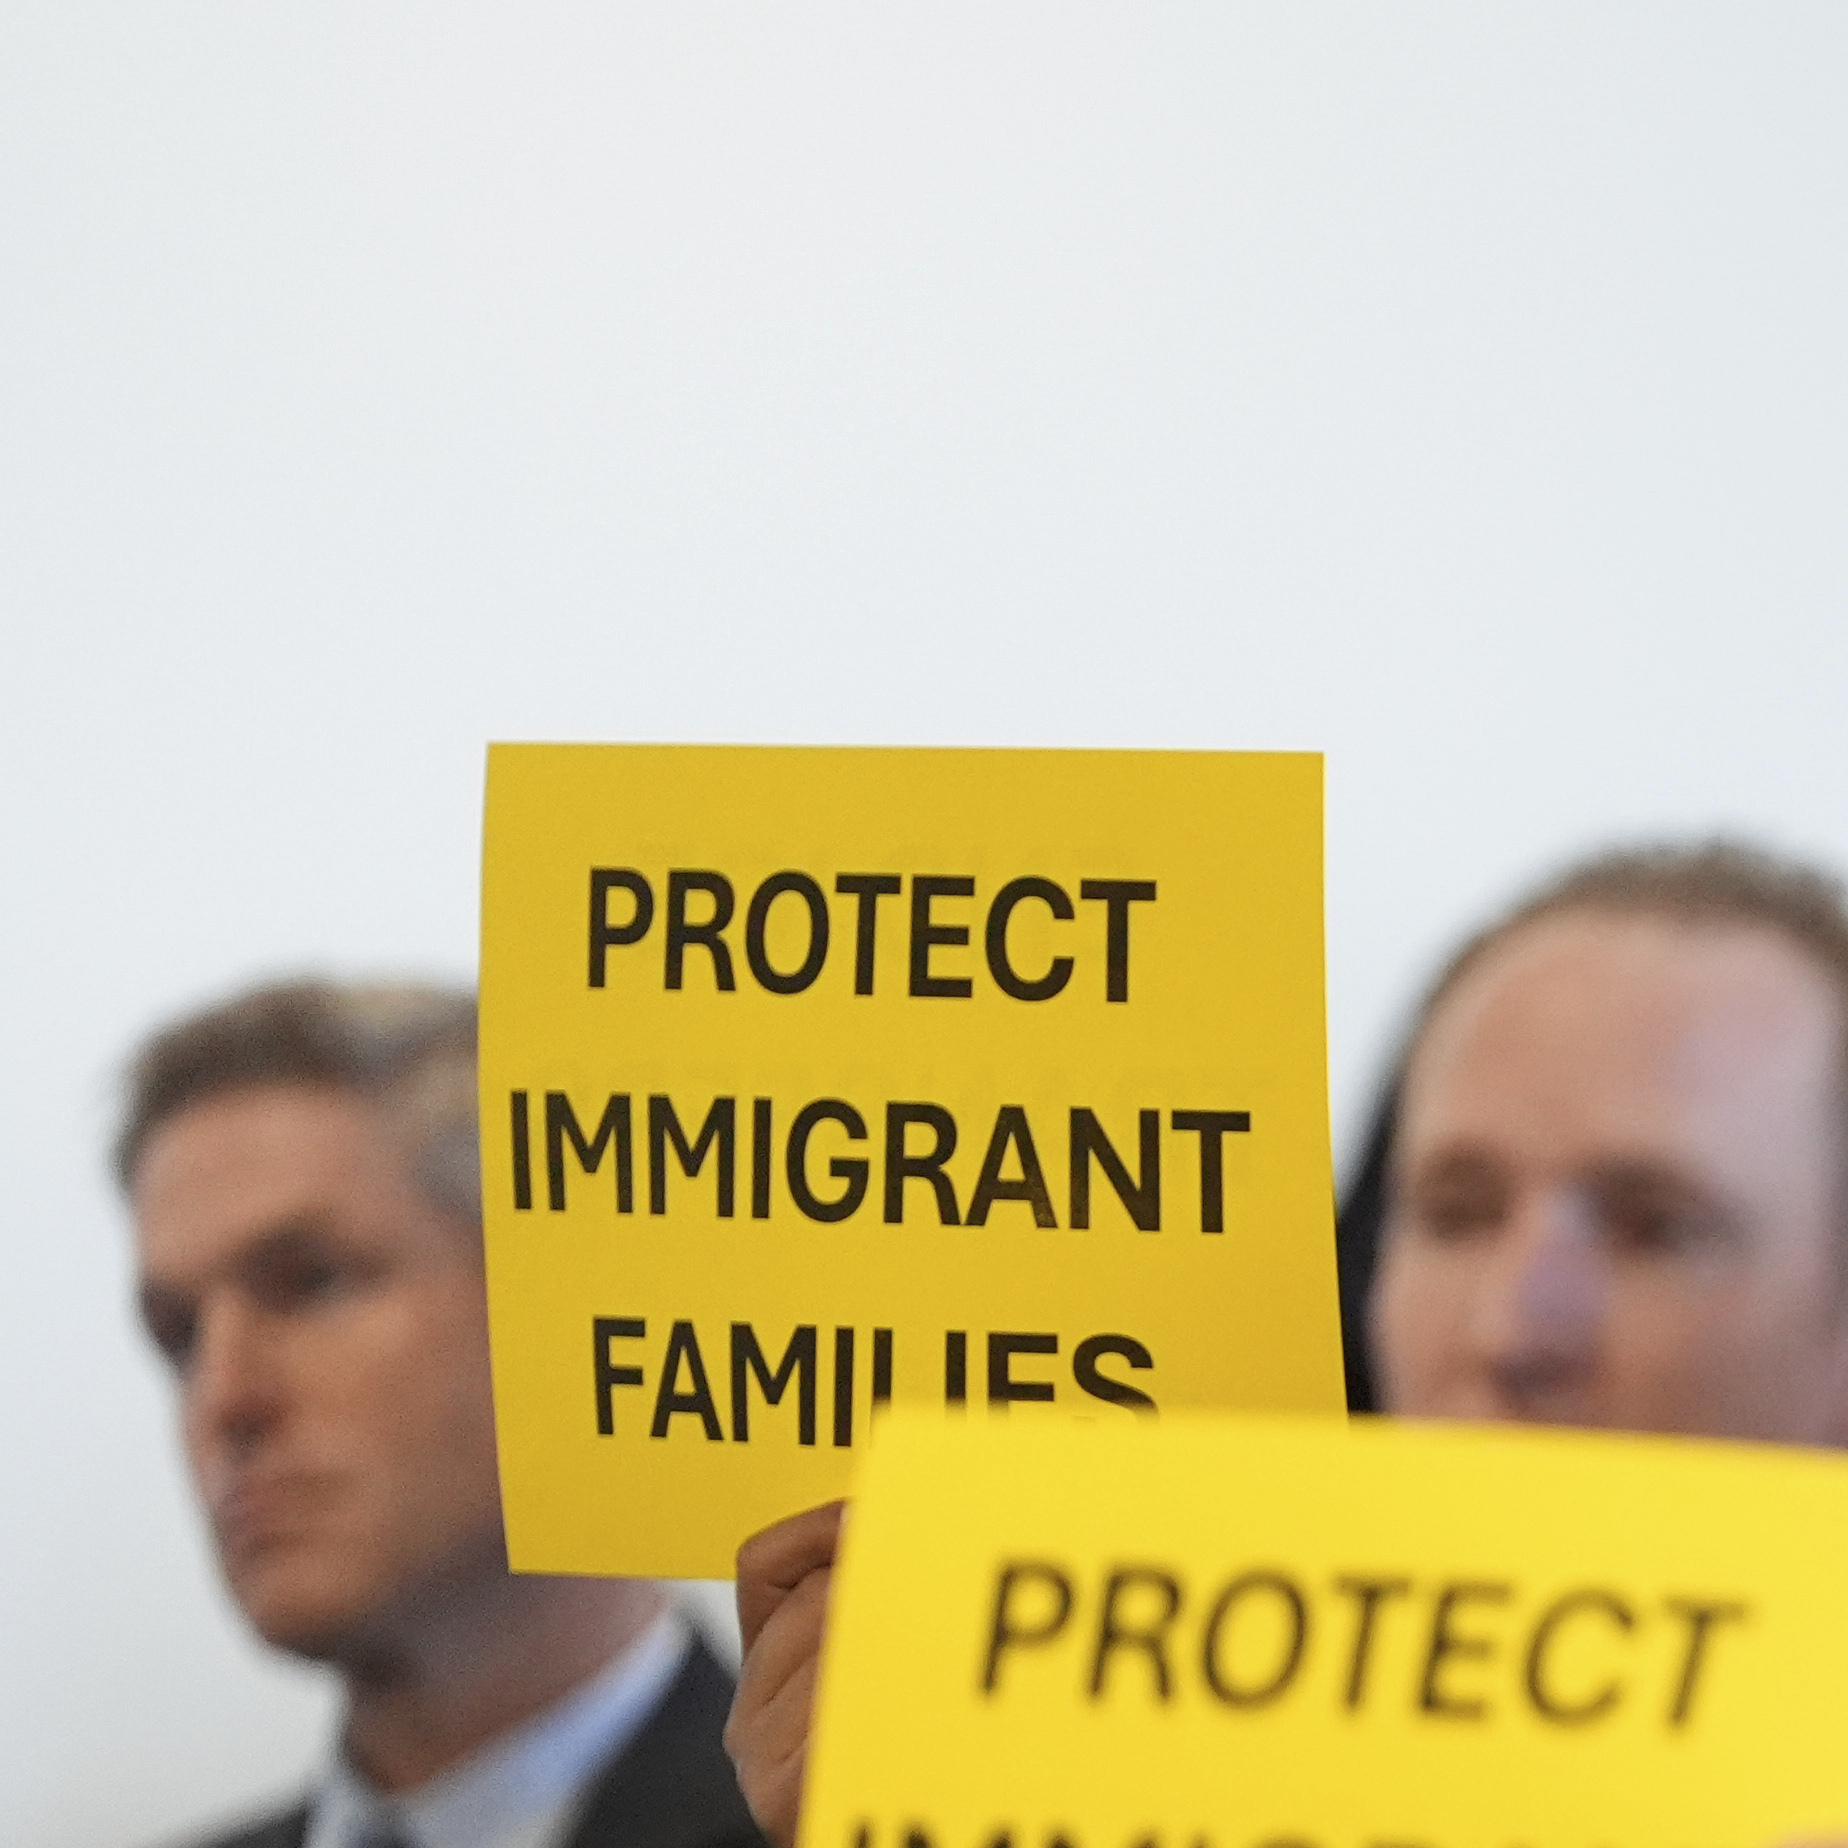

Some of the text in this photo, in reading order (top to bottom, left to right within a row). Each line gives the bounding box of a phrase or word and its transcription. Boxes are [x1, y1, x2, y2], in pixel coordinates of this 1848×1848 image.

[587, 867, 1158, 1003] PROTECT
[510, 1090, 1252, 1235] IMMIGRANT
[974, 1556, 1745, 1732] PROTECT
